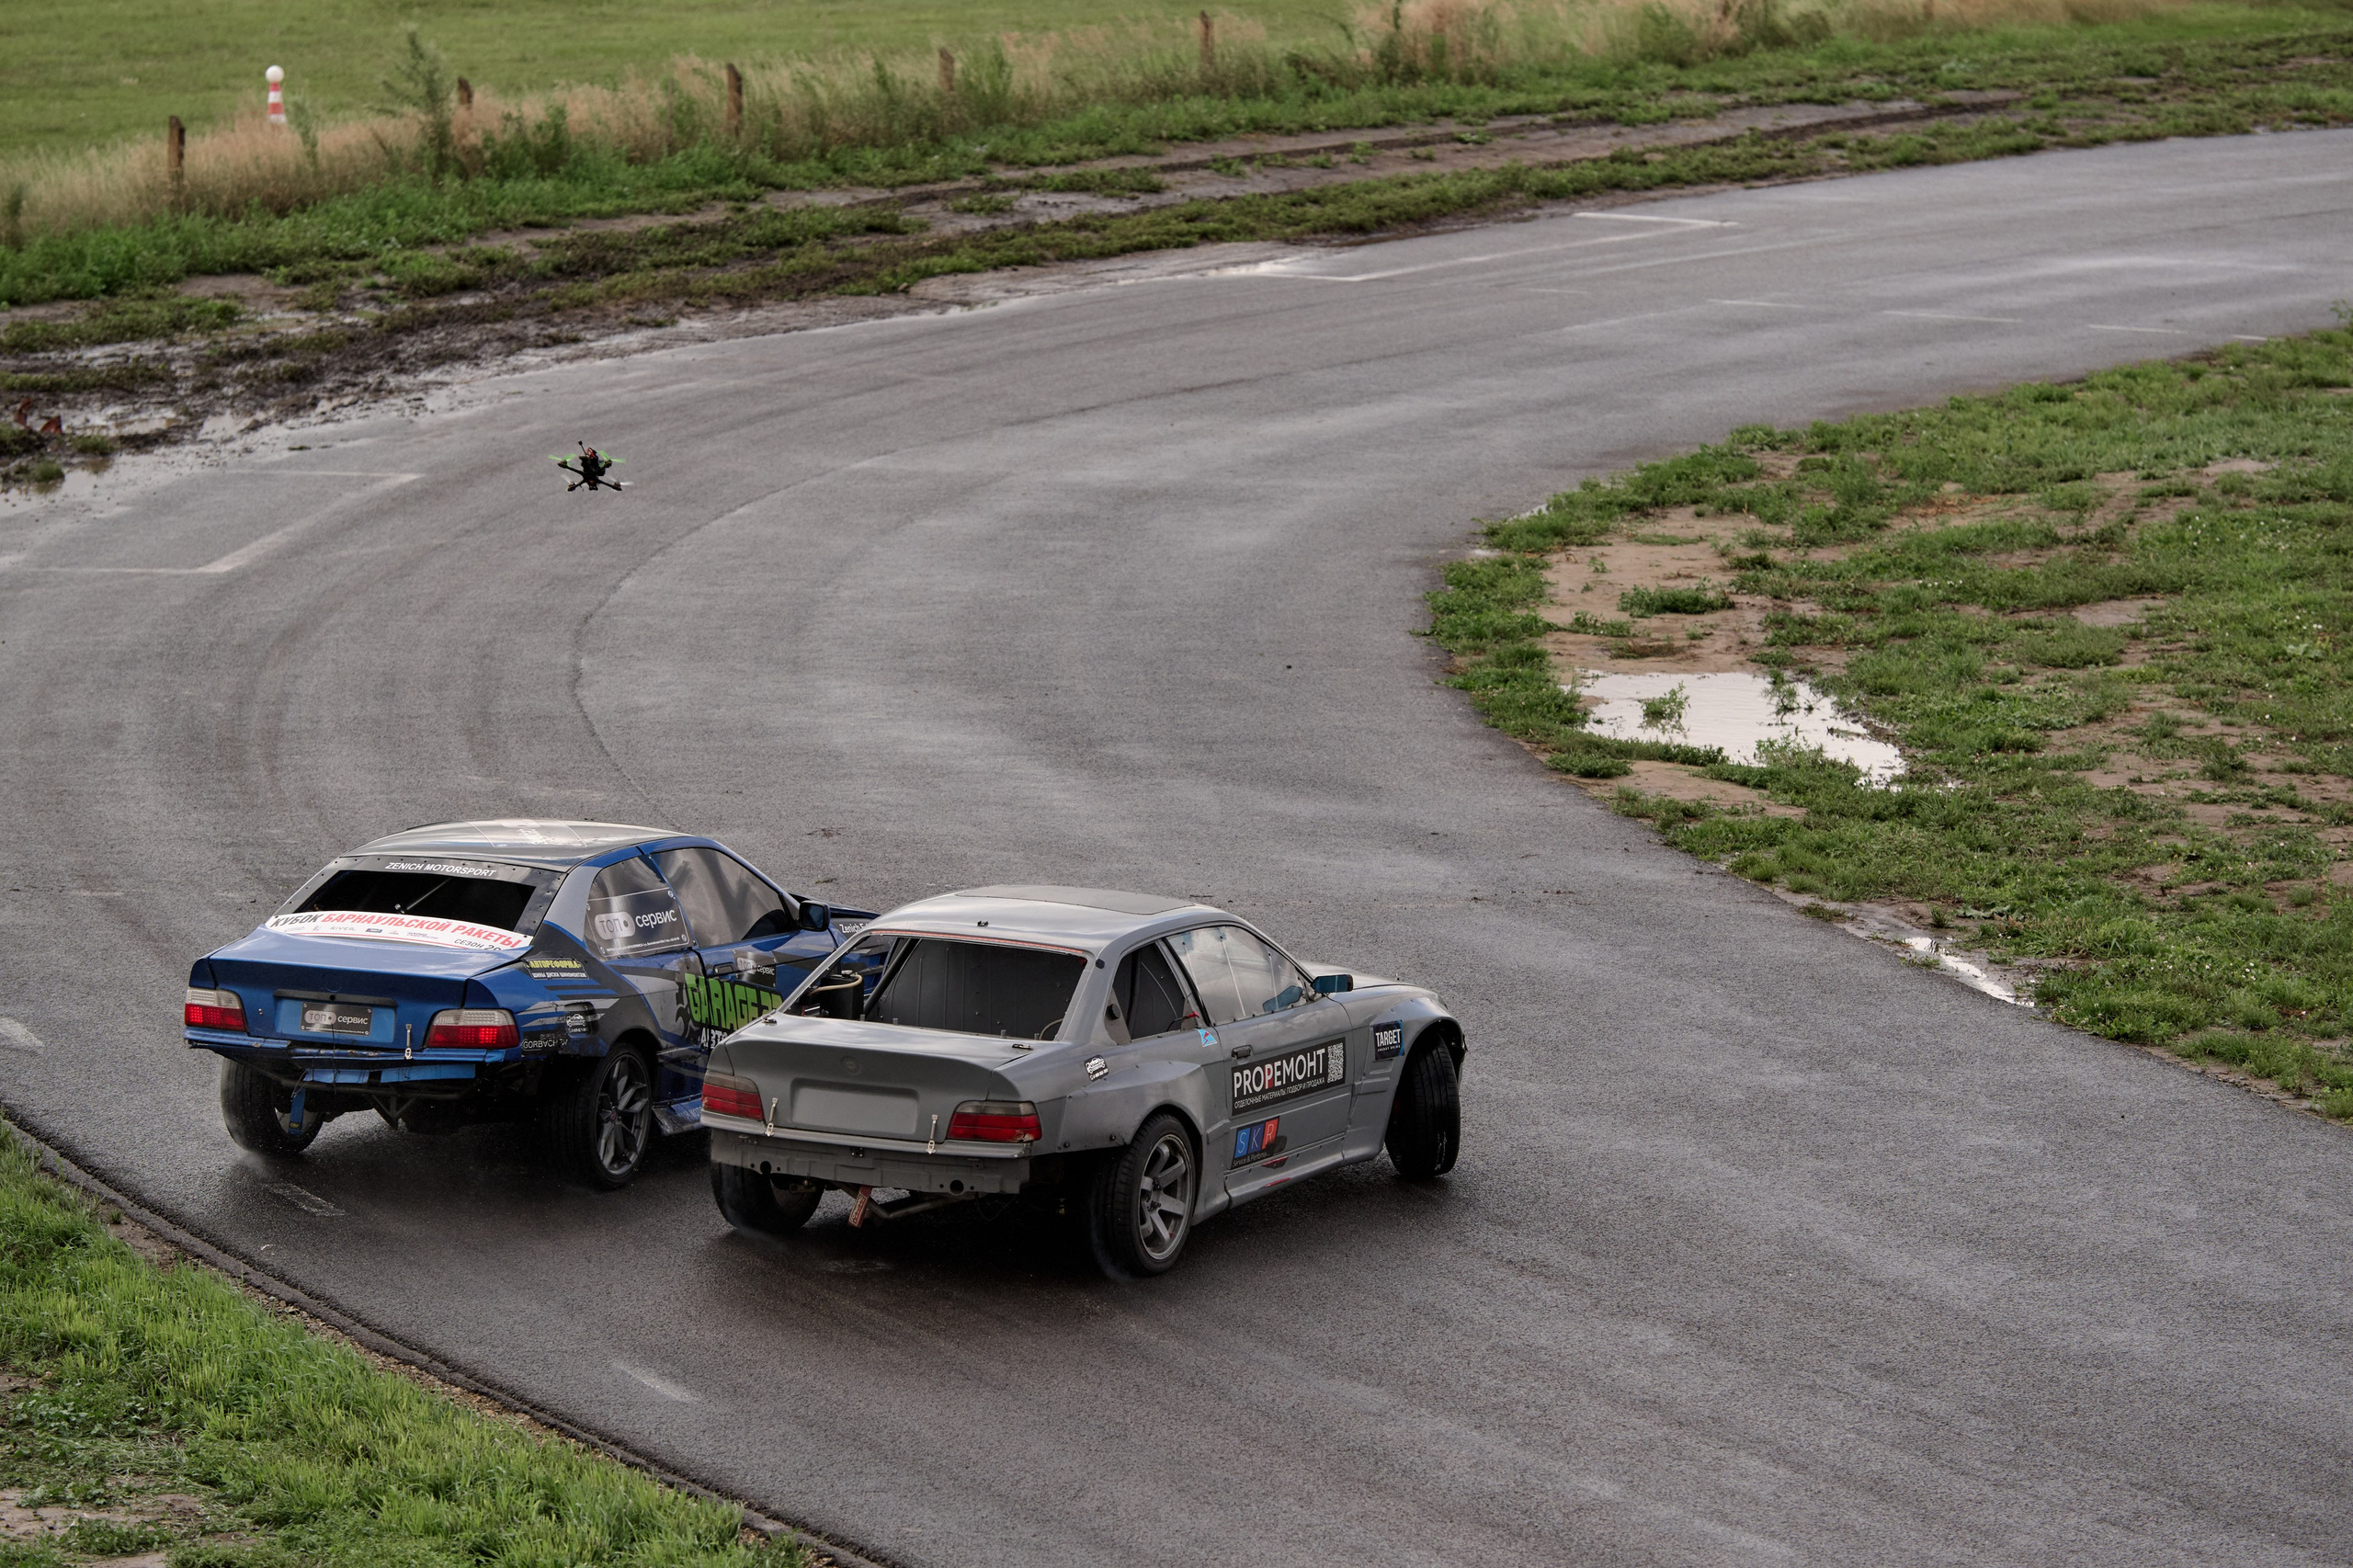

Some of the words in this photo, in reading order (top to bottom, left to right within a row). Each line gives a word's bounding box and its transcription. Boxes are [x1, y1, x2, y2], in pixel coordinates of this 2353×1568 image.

[385, 862, 425, 870] ZENICH
[424, 863, 496, 877] MOTORSPORT
[270, 915, 324, 927] КУБОК
[322, 914, 453, 932] БАРНАУЛЬСКОЙ
[450, 925, 522, 949] РАКЕТЫ
[599, 918, 623, 934] ТОП
[635, 909, 677, 929] сервис
[454, 938, 484, 949] СЕЗОН
[684, 972, 759, 1031] GARAGE
[310, 1013, 327, 1021] ТОП
[337, 1016, 369, 1025] сервис
[1375, 1028, 1402, 1048] TARGET
[1234, 1095, 1262, 1108] ОТДЕЛОЧНЫЕ
[1287, 1083, 1303, 1094] ПОДБОР
[1305, 1076, 1325, 1088] ПРОДАЖА
[1237, 1123, 1275, 1153] SKR
